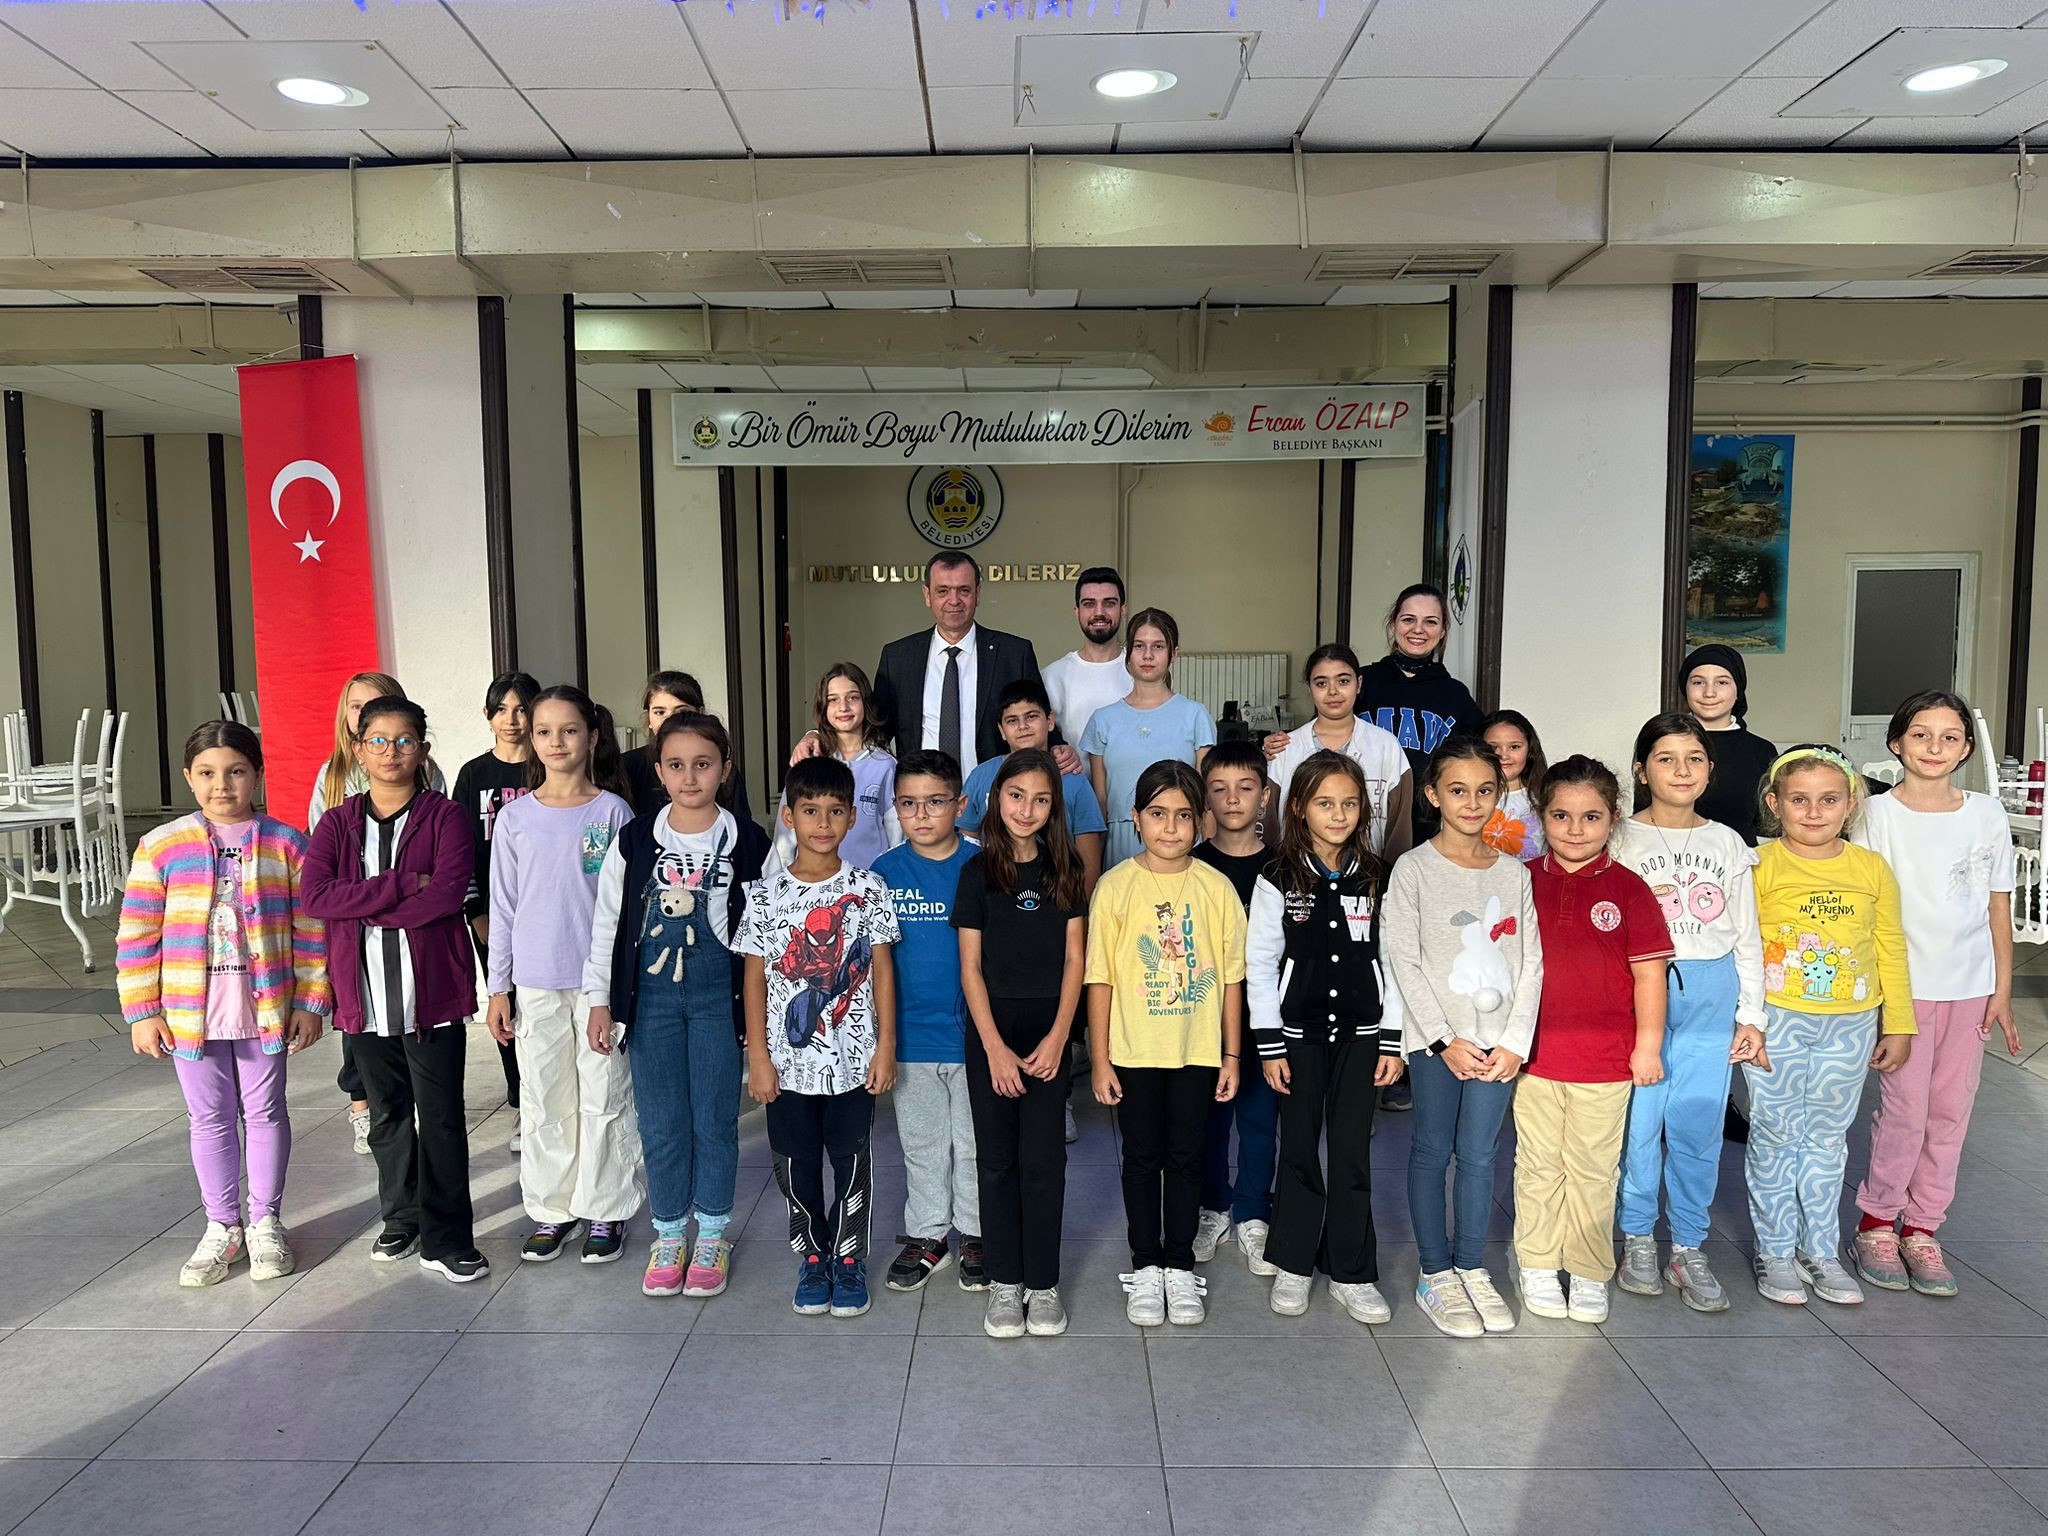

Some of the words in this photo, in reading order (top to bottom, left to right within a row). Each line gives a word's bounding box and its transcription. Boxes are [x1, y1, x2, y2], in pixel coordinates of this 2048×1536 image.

[1248, 404, 1306, 432] Ercan
[1315, 397, 1409, 431] ÖZALP
[728, 411, 782, 448] Bir
[787, 401, 860, 448] Ömür
[862, 411, 938, 458] Boyu
[940, 410, 1089, 452] Mutluluklar
[1091, 408, 1192, 446] Dilerim
[1332, 438, 1382, 451] BAŞKANI
[1799, 904, 1813, 914] MY
[1818, 905, 1855, 915] FRIENDS
[1144, 972, 1157, 980] GET
